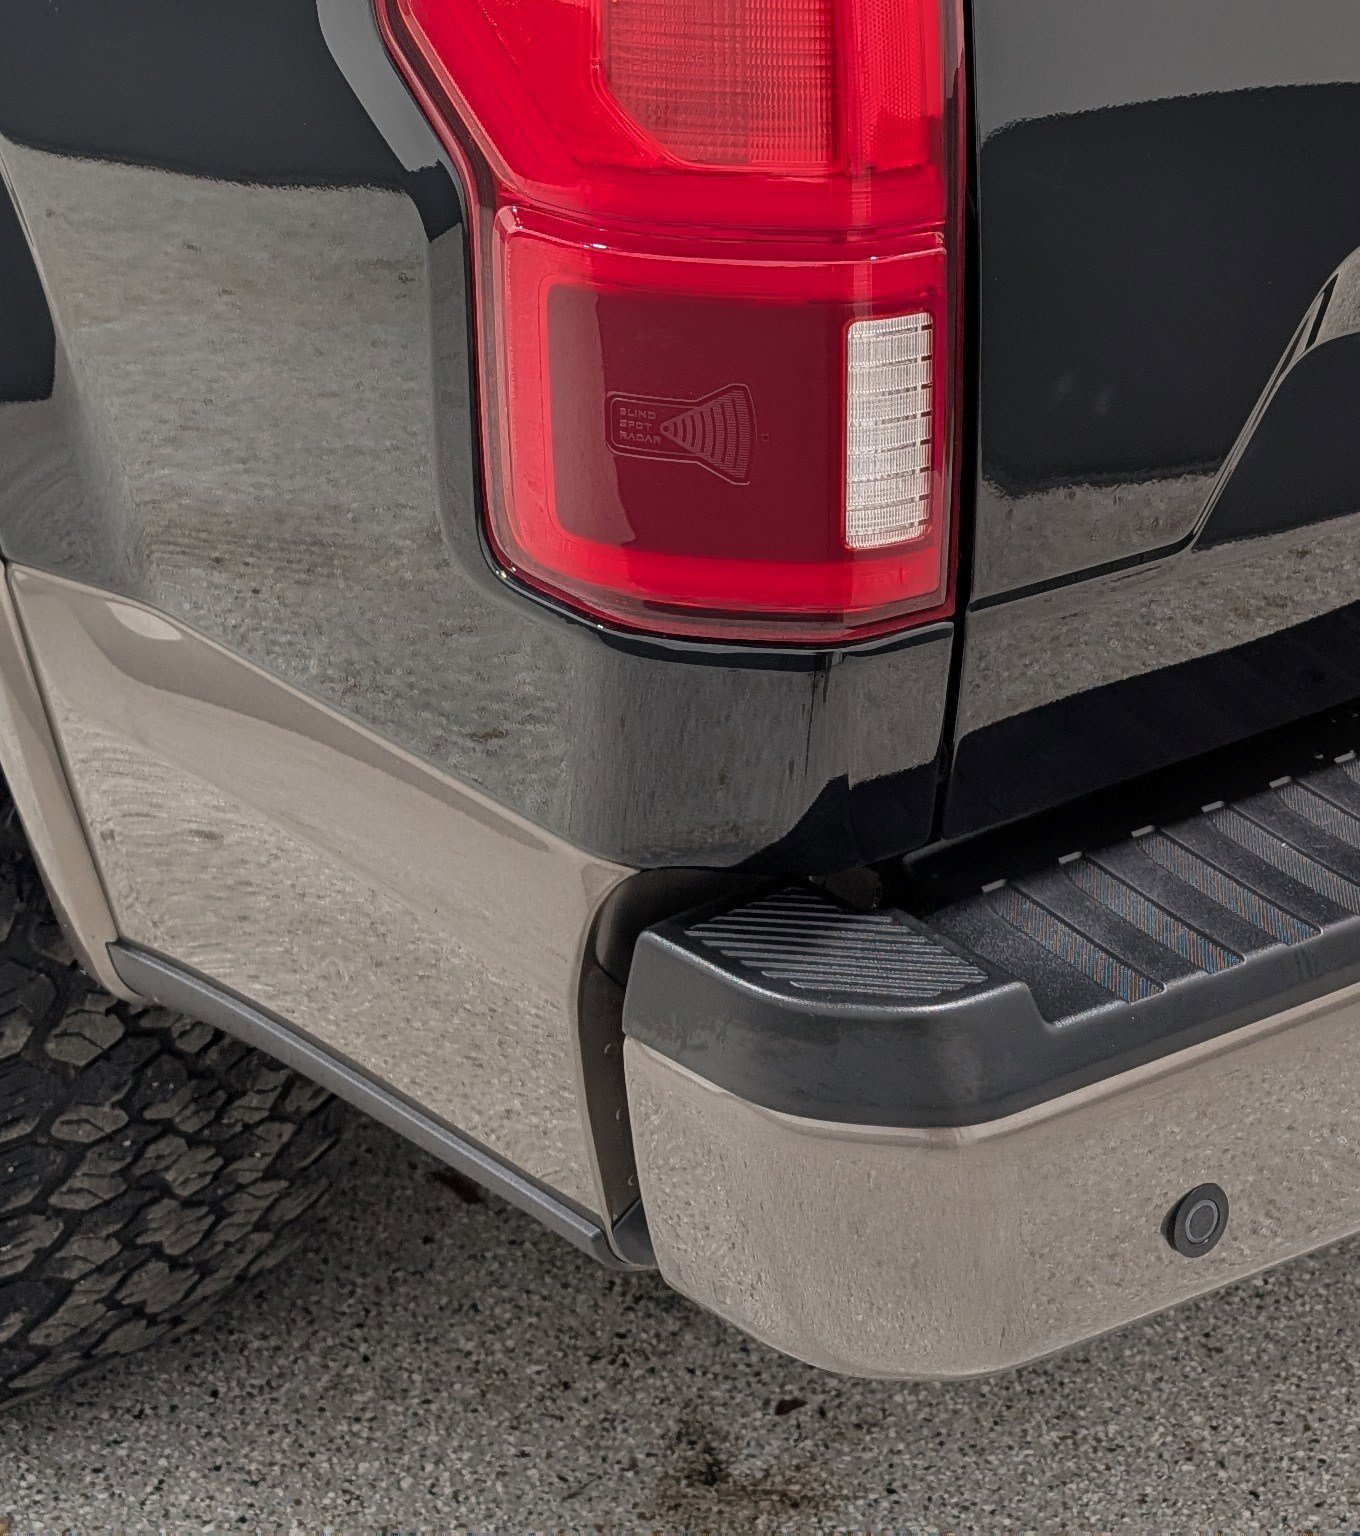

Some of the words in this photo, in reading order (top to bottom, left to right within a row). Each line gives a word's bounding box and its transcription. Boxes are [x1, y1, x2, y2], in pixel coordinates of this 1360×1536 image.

[619, 407, 656, 420] BLIND
[619, 419, 652, 432] SPOT
[619, 430, 662, 444] RADAR
